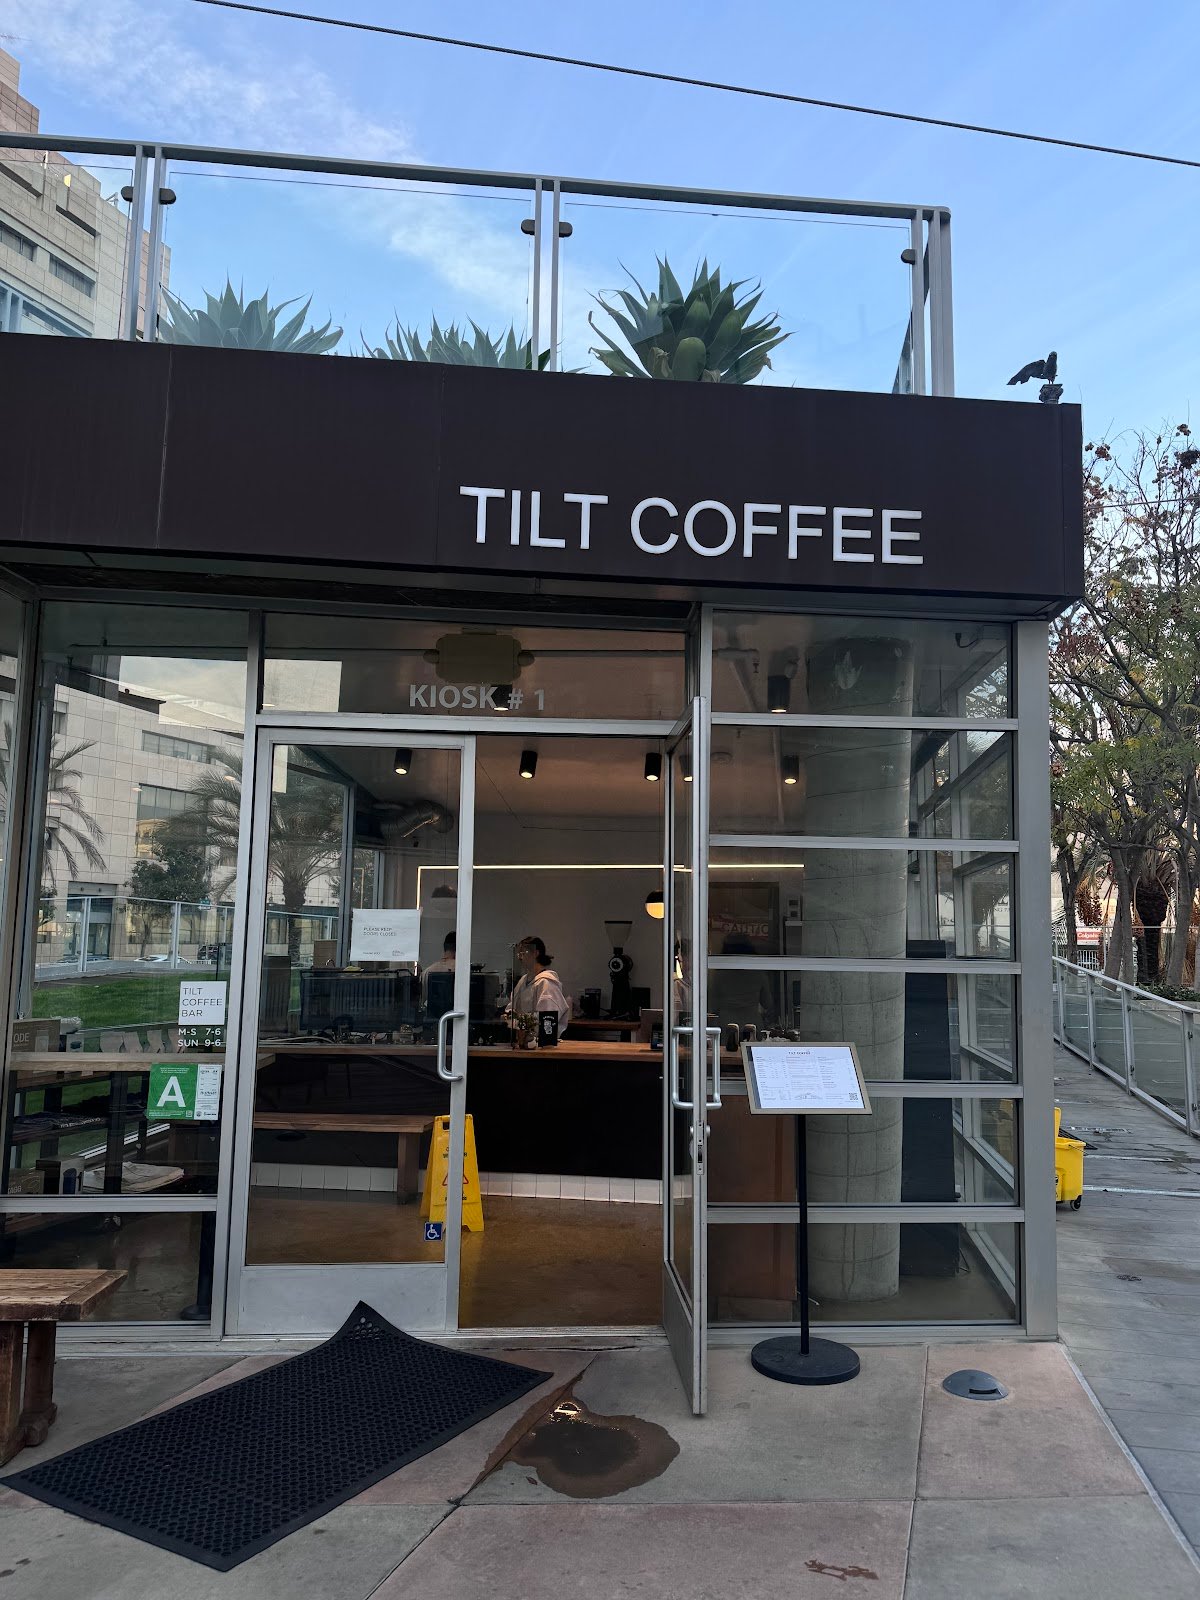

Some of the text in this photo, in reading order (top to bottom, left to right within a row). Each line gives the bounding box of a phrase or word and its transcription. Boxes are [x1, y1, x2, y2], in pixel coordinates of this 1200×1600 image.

[460, 486, 923, 564] TILT COFFEE
[409, 684, 545, 711] KIOSK # 1
[183, 987, 203, 995] TILT
[182, 998, 223, 1006] COFFEE
[181, 1009, 203, 1017] BAR
[178, 1028, 221, 1036] M-S 7-6
[177, 1039, 221, 1047] SUN 9-6
[156, 1075, 187, 1108] A
